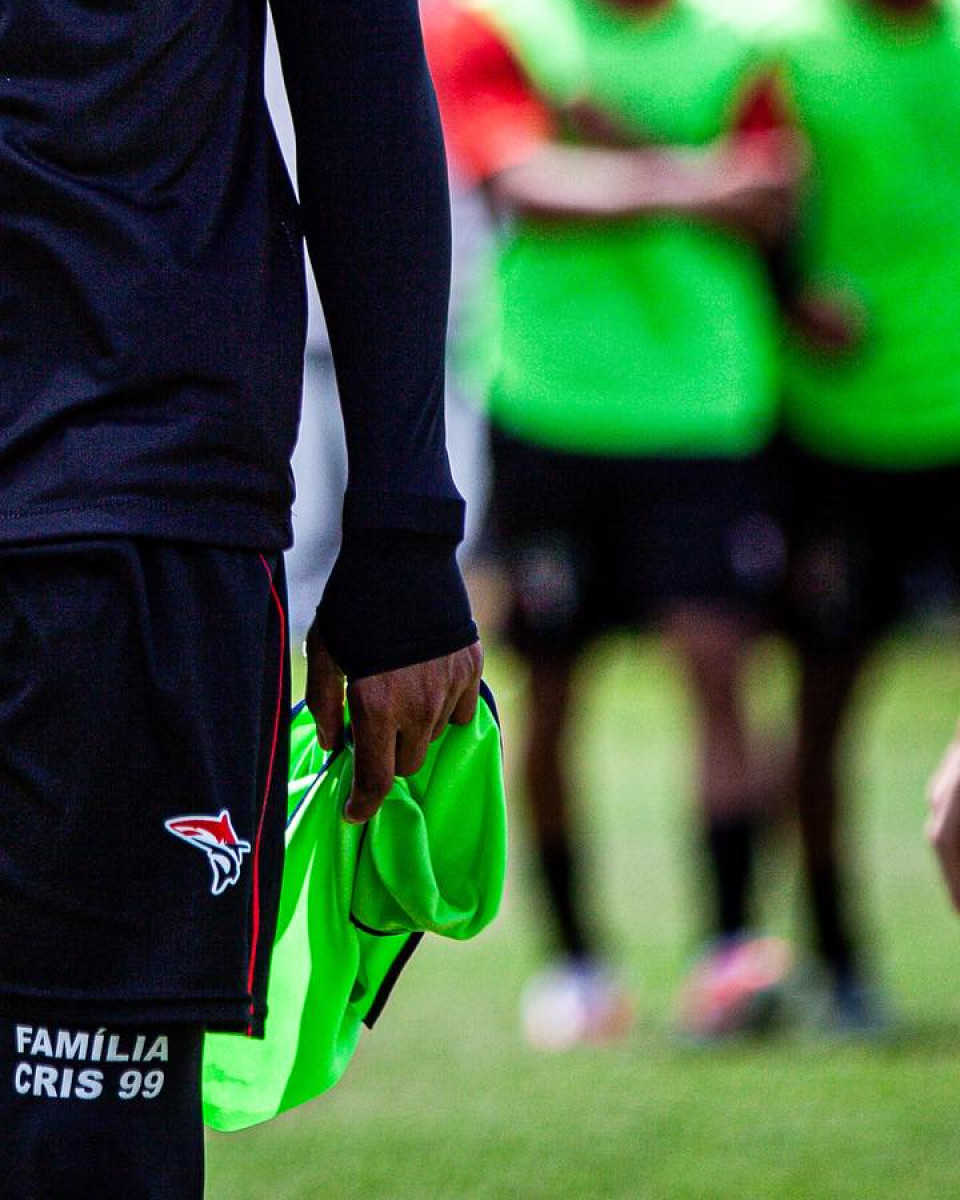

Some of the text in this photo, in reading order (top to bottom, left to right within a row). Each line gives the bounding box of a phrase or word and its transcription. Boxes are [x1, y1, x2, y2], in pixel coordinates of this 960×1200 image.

[16, 1026, 169, 1062] FAMÍLIA
[15, 1063, 165, 1100] CRIS 99
